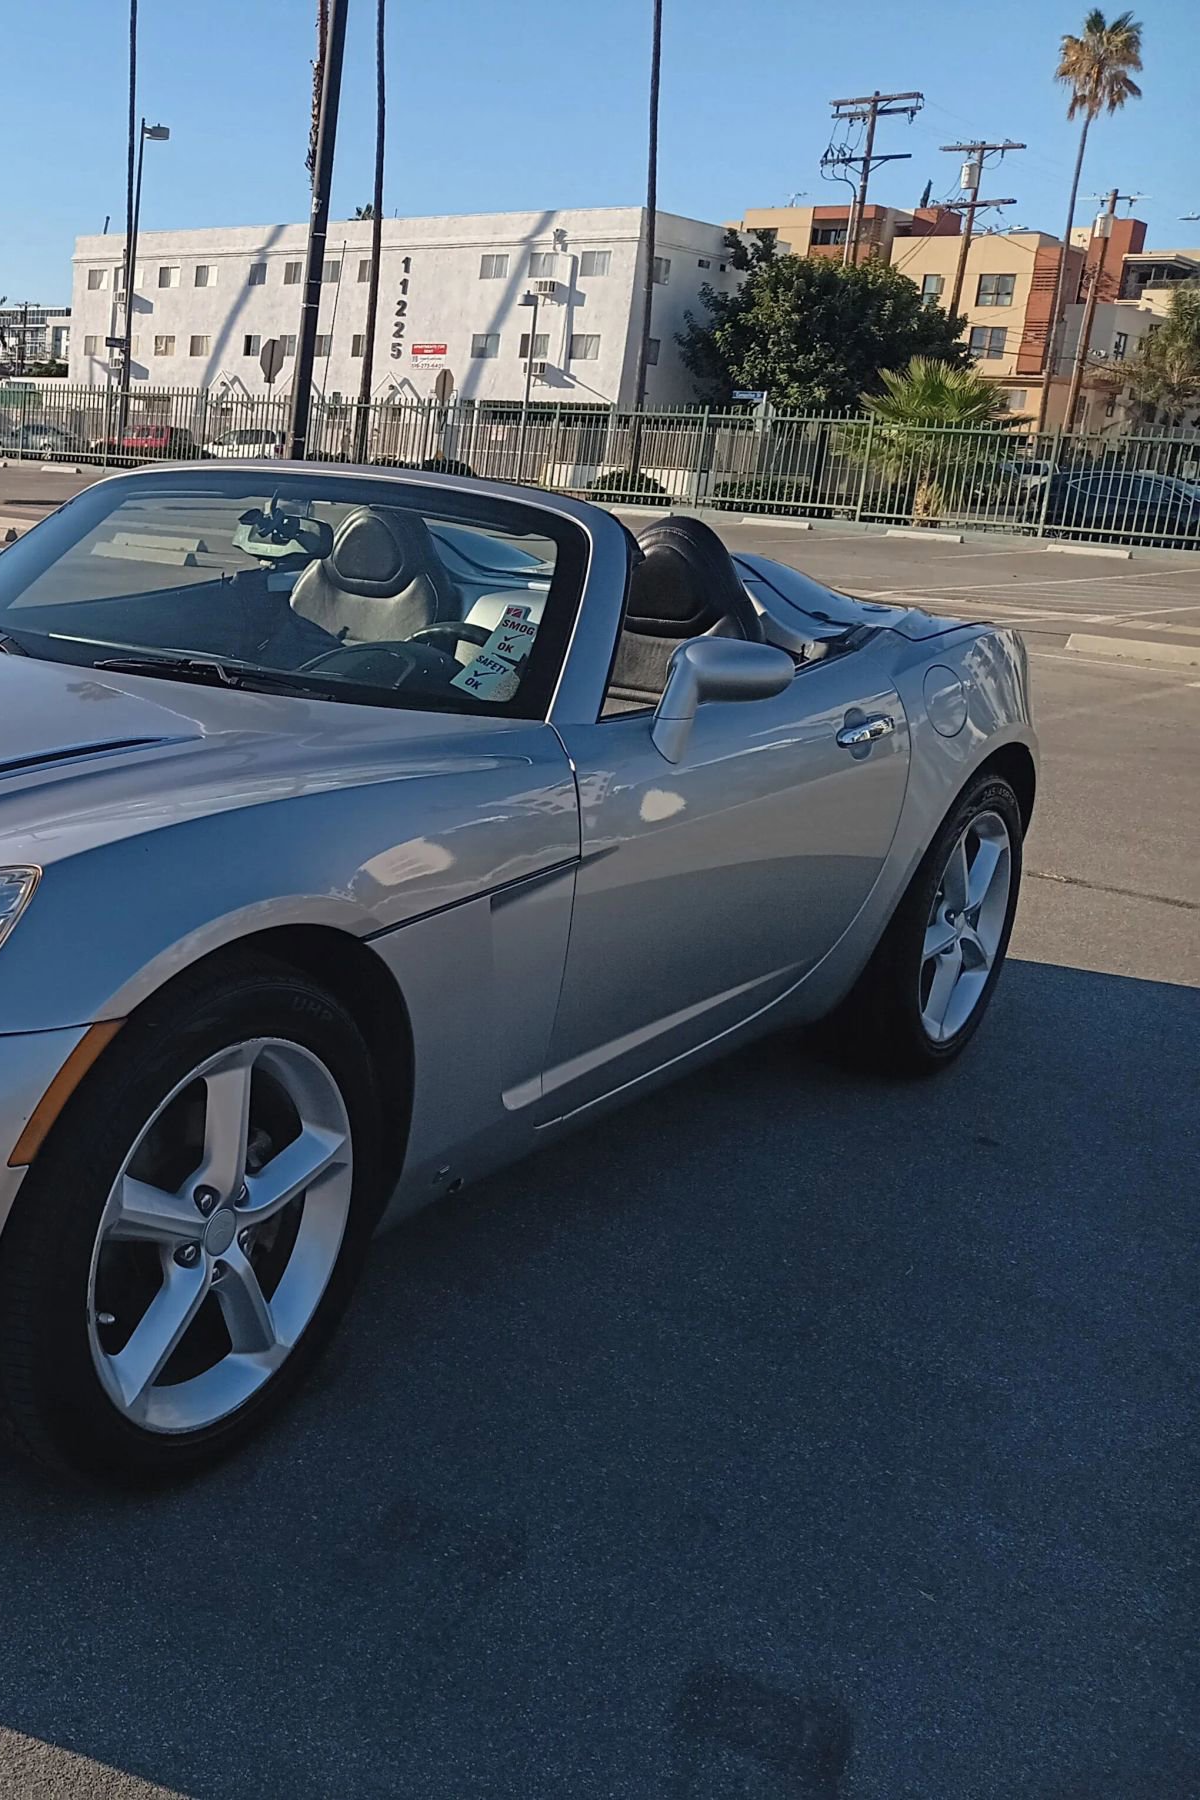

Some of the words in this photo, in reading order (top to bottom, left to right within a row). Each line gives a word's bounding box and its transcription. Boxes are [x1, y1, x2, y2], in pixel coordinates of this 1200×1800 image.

[390, 256, 412, 360] 11225
[502, 619, 535, 636] SMOG
[497, 642, 515, 653] OK
[476, 655, 509, 675] SAFETY
[464, 677, 483, 690] OK
